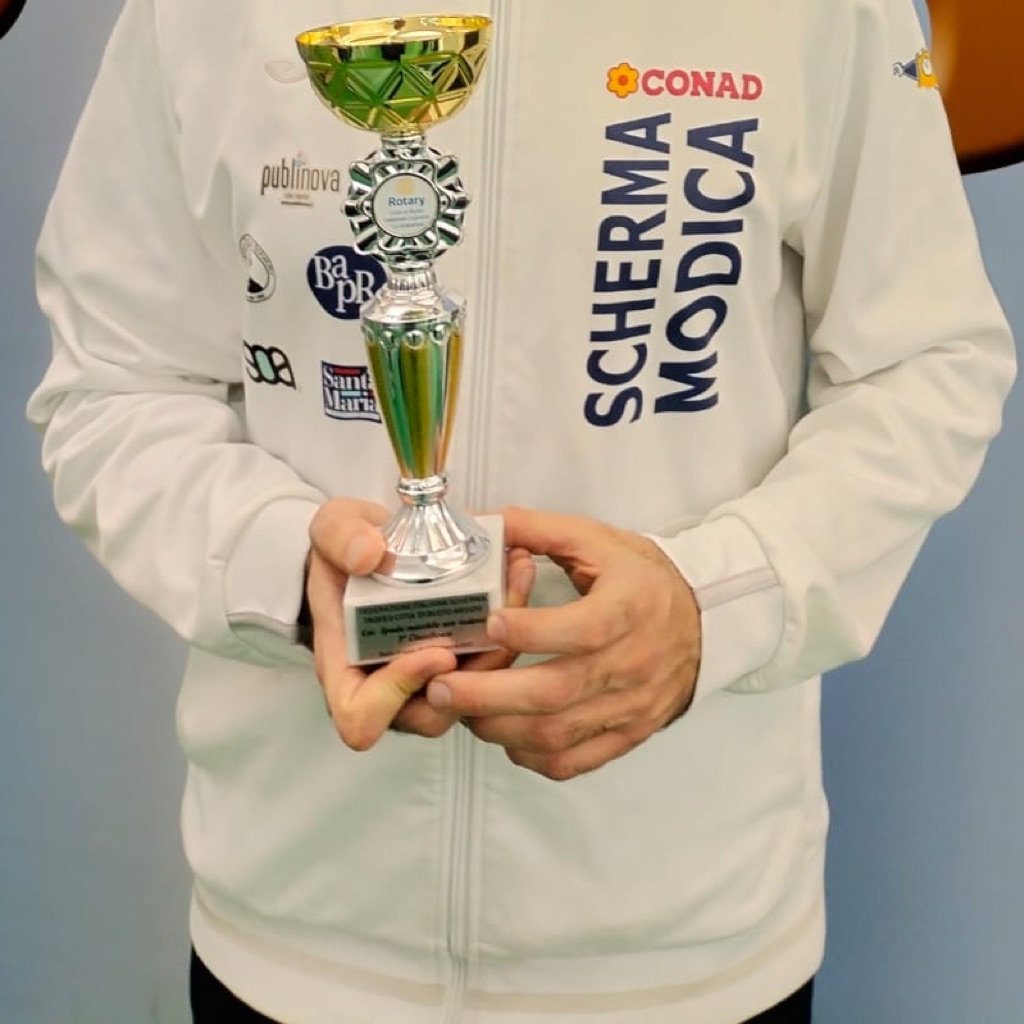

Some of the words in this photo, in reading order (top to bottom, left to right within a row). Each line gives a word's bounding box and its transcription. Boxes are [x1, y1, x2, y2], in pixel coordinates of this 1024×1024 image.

[642, 68, 763, 101] CONAD
[260, 157, 340, 196] publinova
[388, 196, 425, 207] Rotary
[583, 112, 671, 428] SCHERMA
[654, 117, 759, 414] MODICA
[323, 366, 369, 390] Sant
